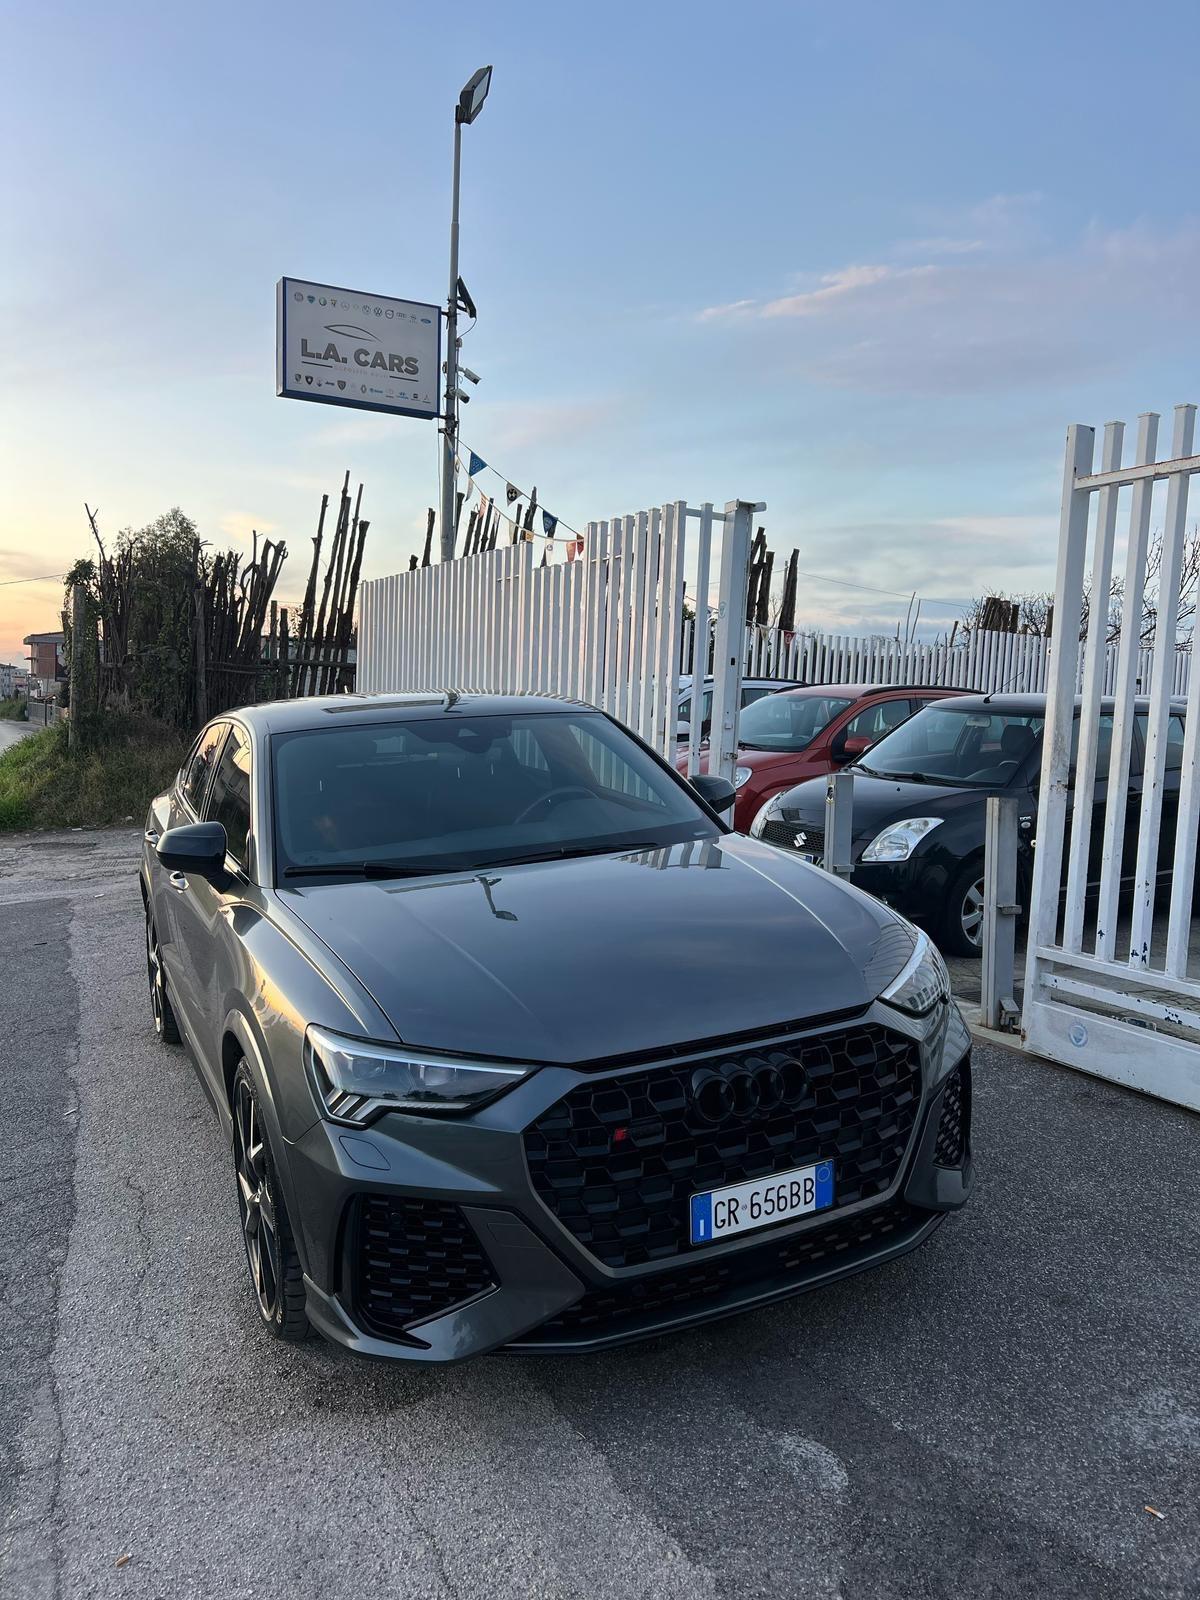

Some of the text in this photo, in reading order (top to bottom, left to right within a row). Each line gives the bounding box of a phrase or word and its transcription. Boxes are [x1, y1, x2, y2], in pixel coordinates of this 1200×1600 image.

[301, 338, 348, 363] L.A.
[354, 348, 419, 375] CARS
[714, 1197, 739, 1229] GR
[750, 1177, 814, 1220] 656BB
